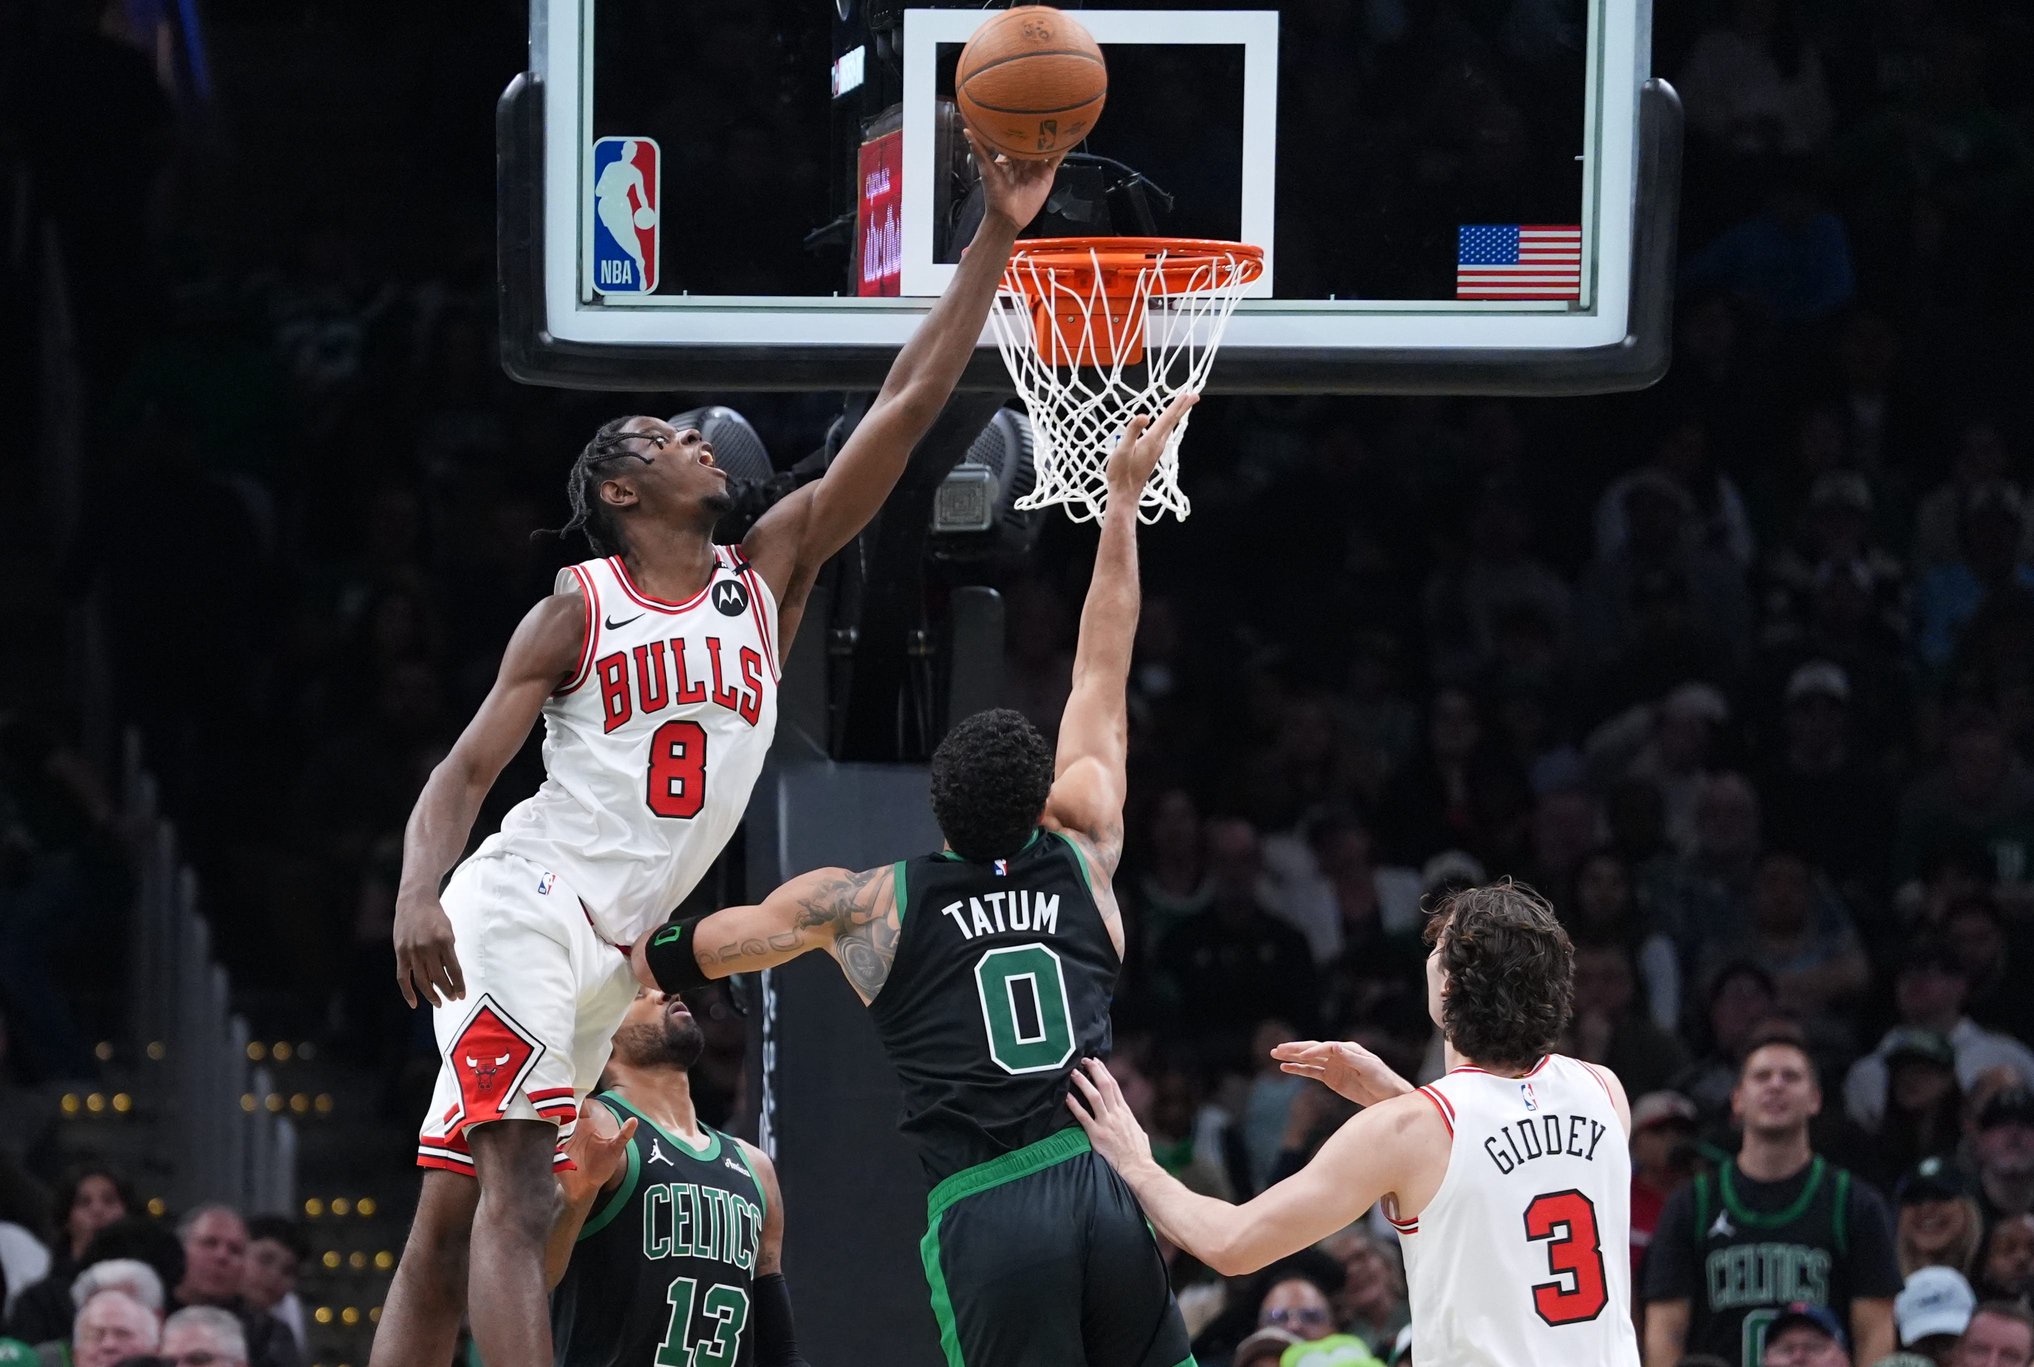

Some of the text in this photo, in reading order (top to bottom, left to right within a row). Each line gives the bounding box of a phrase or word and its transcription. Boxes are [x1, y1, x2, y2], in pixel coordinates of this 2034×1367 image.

[601, 260, 632, 284] NBA
[596, 637, 763, 734] BULLS
[646, 720, 708, 819] 8
[941, 890, 1060, 940] TATUM
[974, 942, 1077, 1075] 0
[1484, 1115, 1606, 1175] GIDDEY
[643, 1182, 763, 1281] CELTICS
[1523, 1188, 1609, 1327] 3
[1706, 1242, 1832, 1312] CELTICS
[654, 1276, 750, 1367] 13
